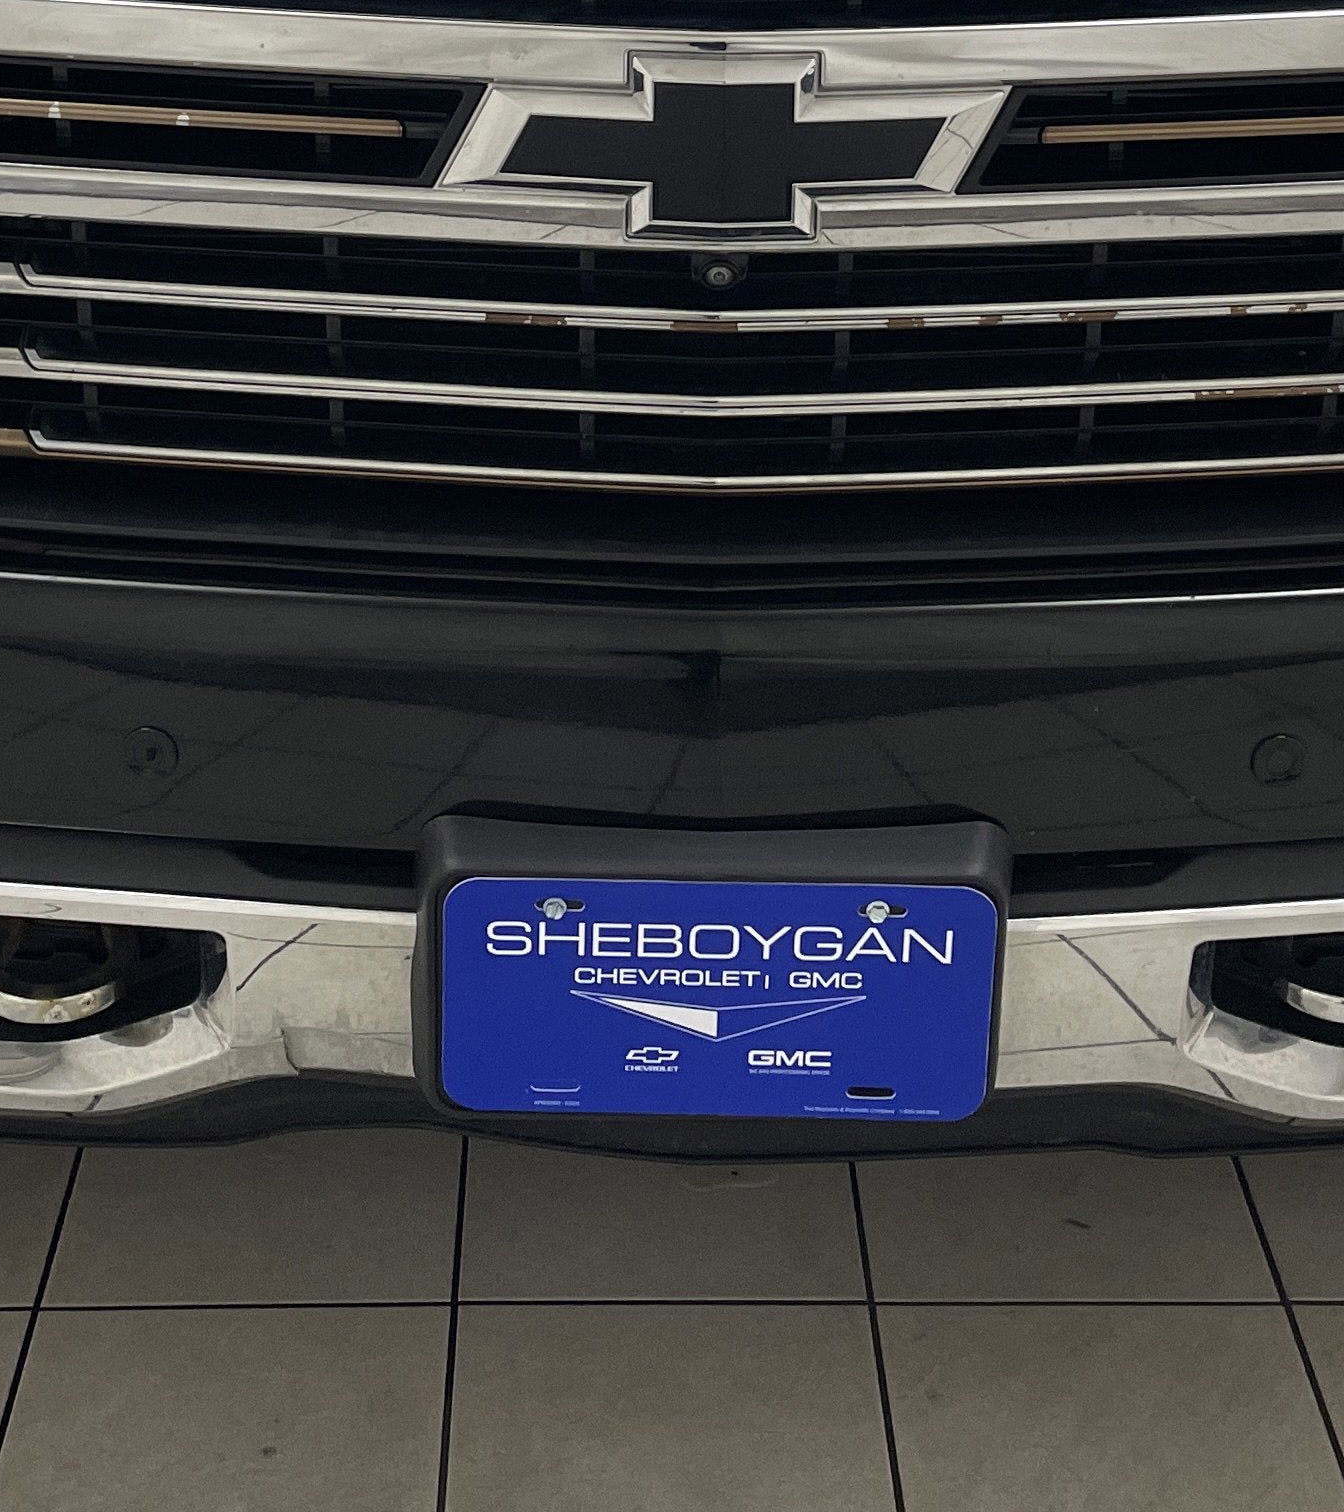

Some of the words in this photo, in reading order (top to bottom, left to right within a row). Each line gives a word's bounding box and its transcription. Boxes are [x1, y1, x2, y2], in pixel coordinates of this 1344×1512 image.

[485, 920, 954, 965] SHEBOYGAN
[573, 966, 761, 988] CHEVROLET
[788, 970, 863, 990] GMC
[747, 1049, 832, 1067] GMC
